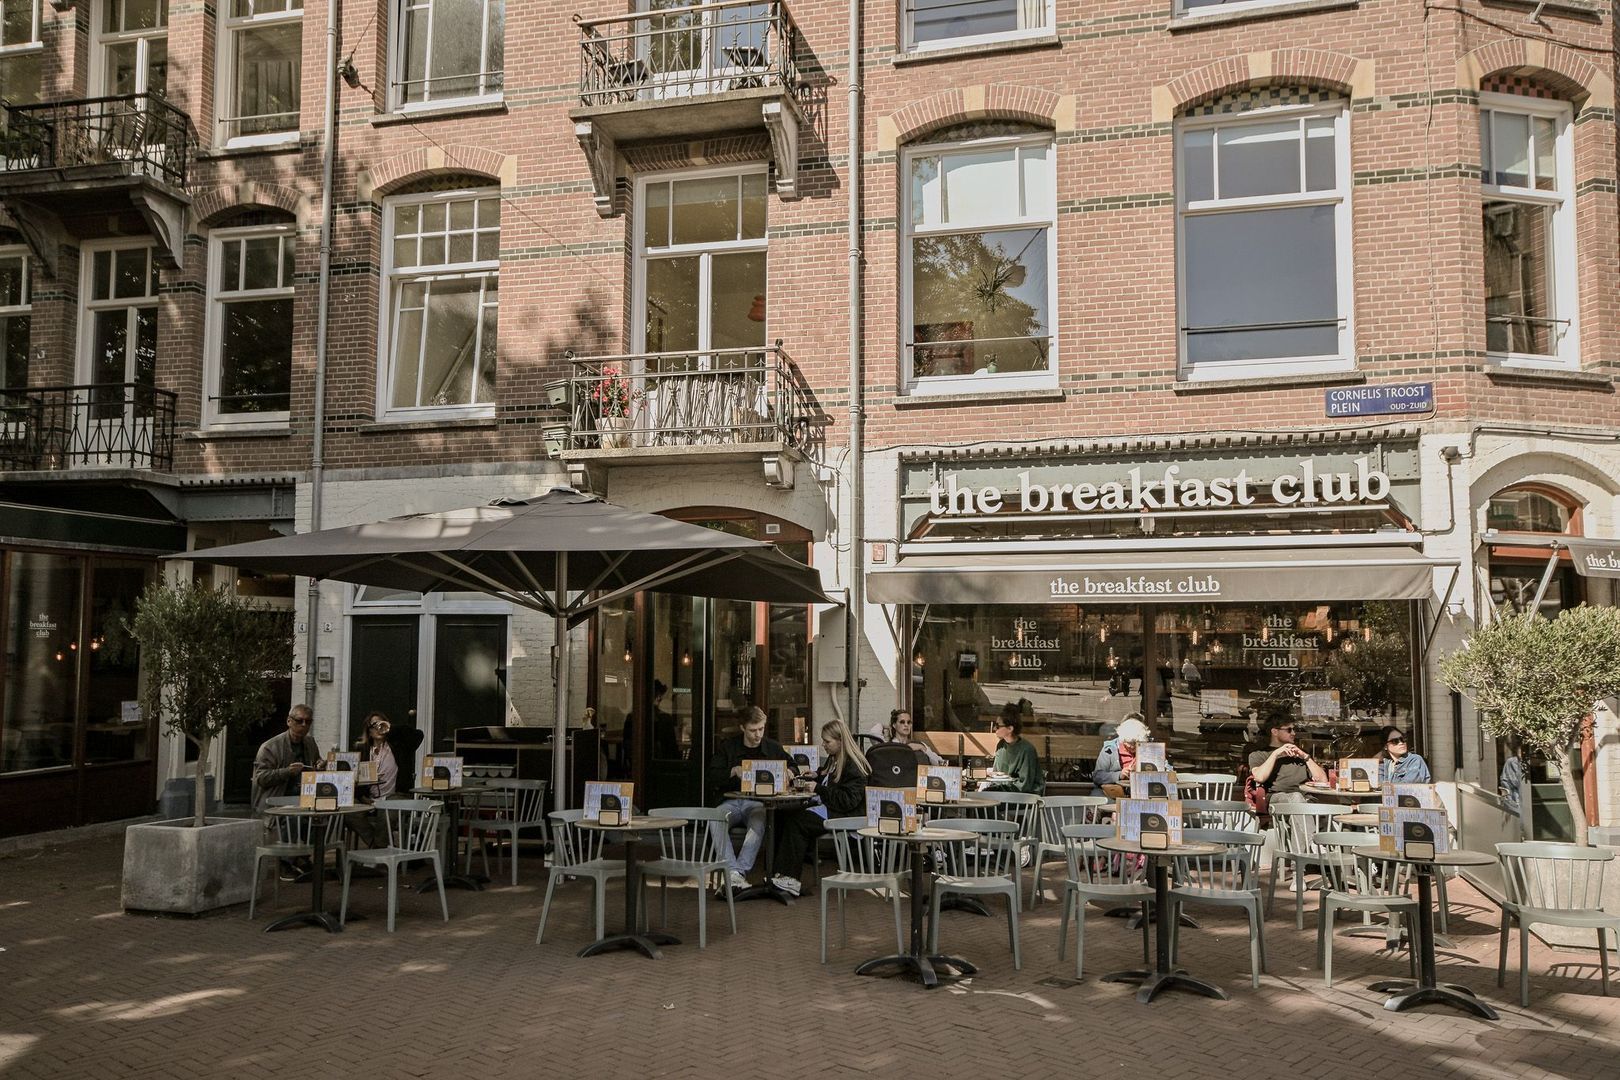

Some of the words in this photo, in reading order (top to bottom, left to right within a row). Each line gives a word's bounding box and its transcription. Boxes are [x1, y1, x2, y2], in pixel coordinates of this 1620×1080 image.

[1331, 389, 1381, 401] CORNELIS
[1384, 386, 1426, 398] TROOST
[1331, 402, 1360, 413] PLEIN
[1390, 401, 1427, 410] OUD-ZUID
[928, 475, 1003, 515] the
[1018, 465, 1256, 513] breakfast
[1272, 456, 1391, 504] club
[1585, 553, 1607, 568] the
[1050, 577, 1080, 594] the
[1084, 576, 1173, 594] breakfast
[1177, 575, 1221, 593] club
[39, 612, 49, 620] the
[1013, 616, 1037, 630] the
[1266, 613, 1292, 627] the
[29, 620, 57, 628] breakfast
[991, 635, 1061, 648] breakfast
[1242, 633, 1319, 648] breakfast
[1009, 654, 1042, 667] club
[1263, 653, 1299, 667] club
